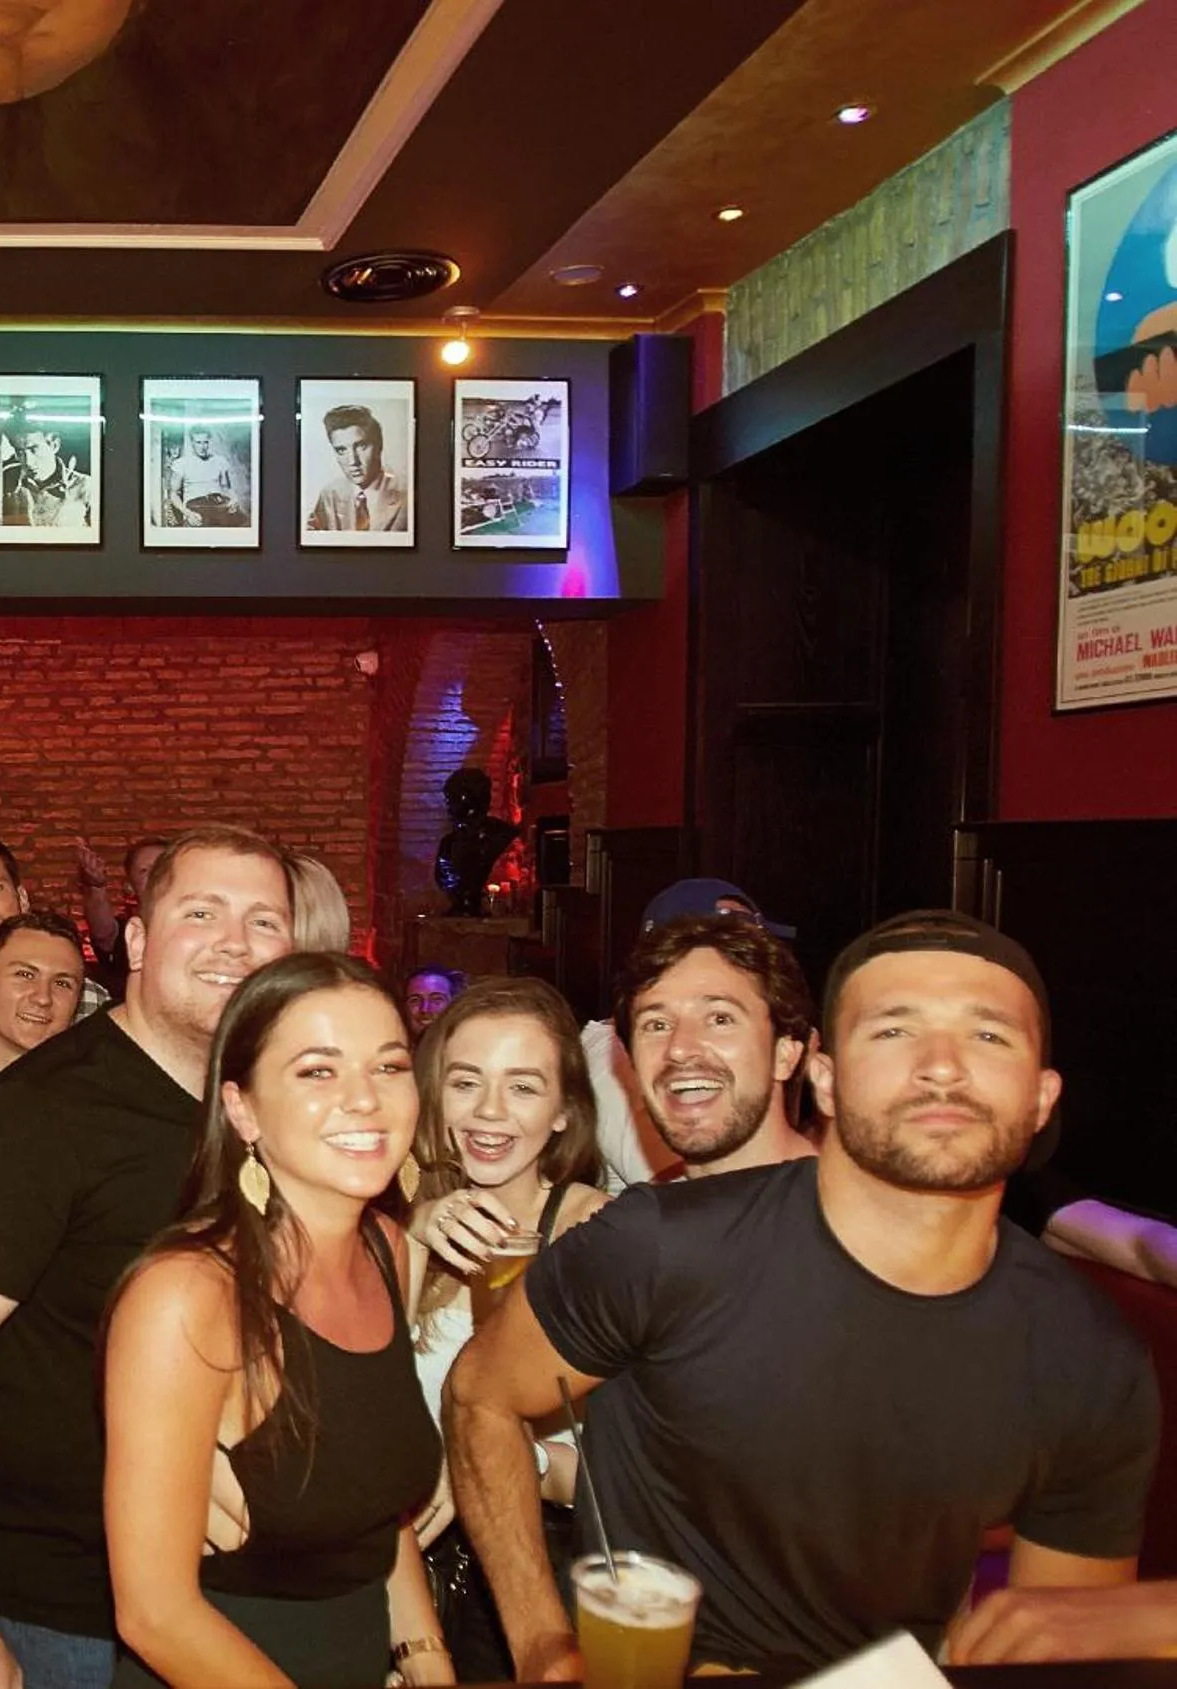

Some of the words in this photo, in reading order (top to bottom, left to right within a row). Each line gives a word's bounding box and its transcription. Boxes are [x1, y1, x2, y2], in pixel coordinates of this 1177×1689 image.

[465, 459, 507, 468] EASY
[511, 459, 558, 468] RIDER
[1076, 632, 1143, 662] MICHAEL
[1149, 623, 1177, 649] WA
